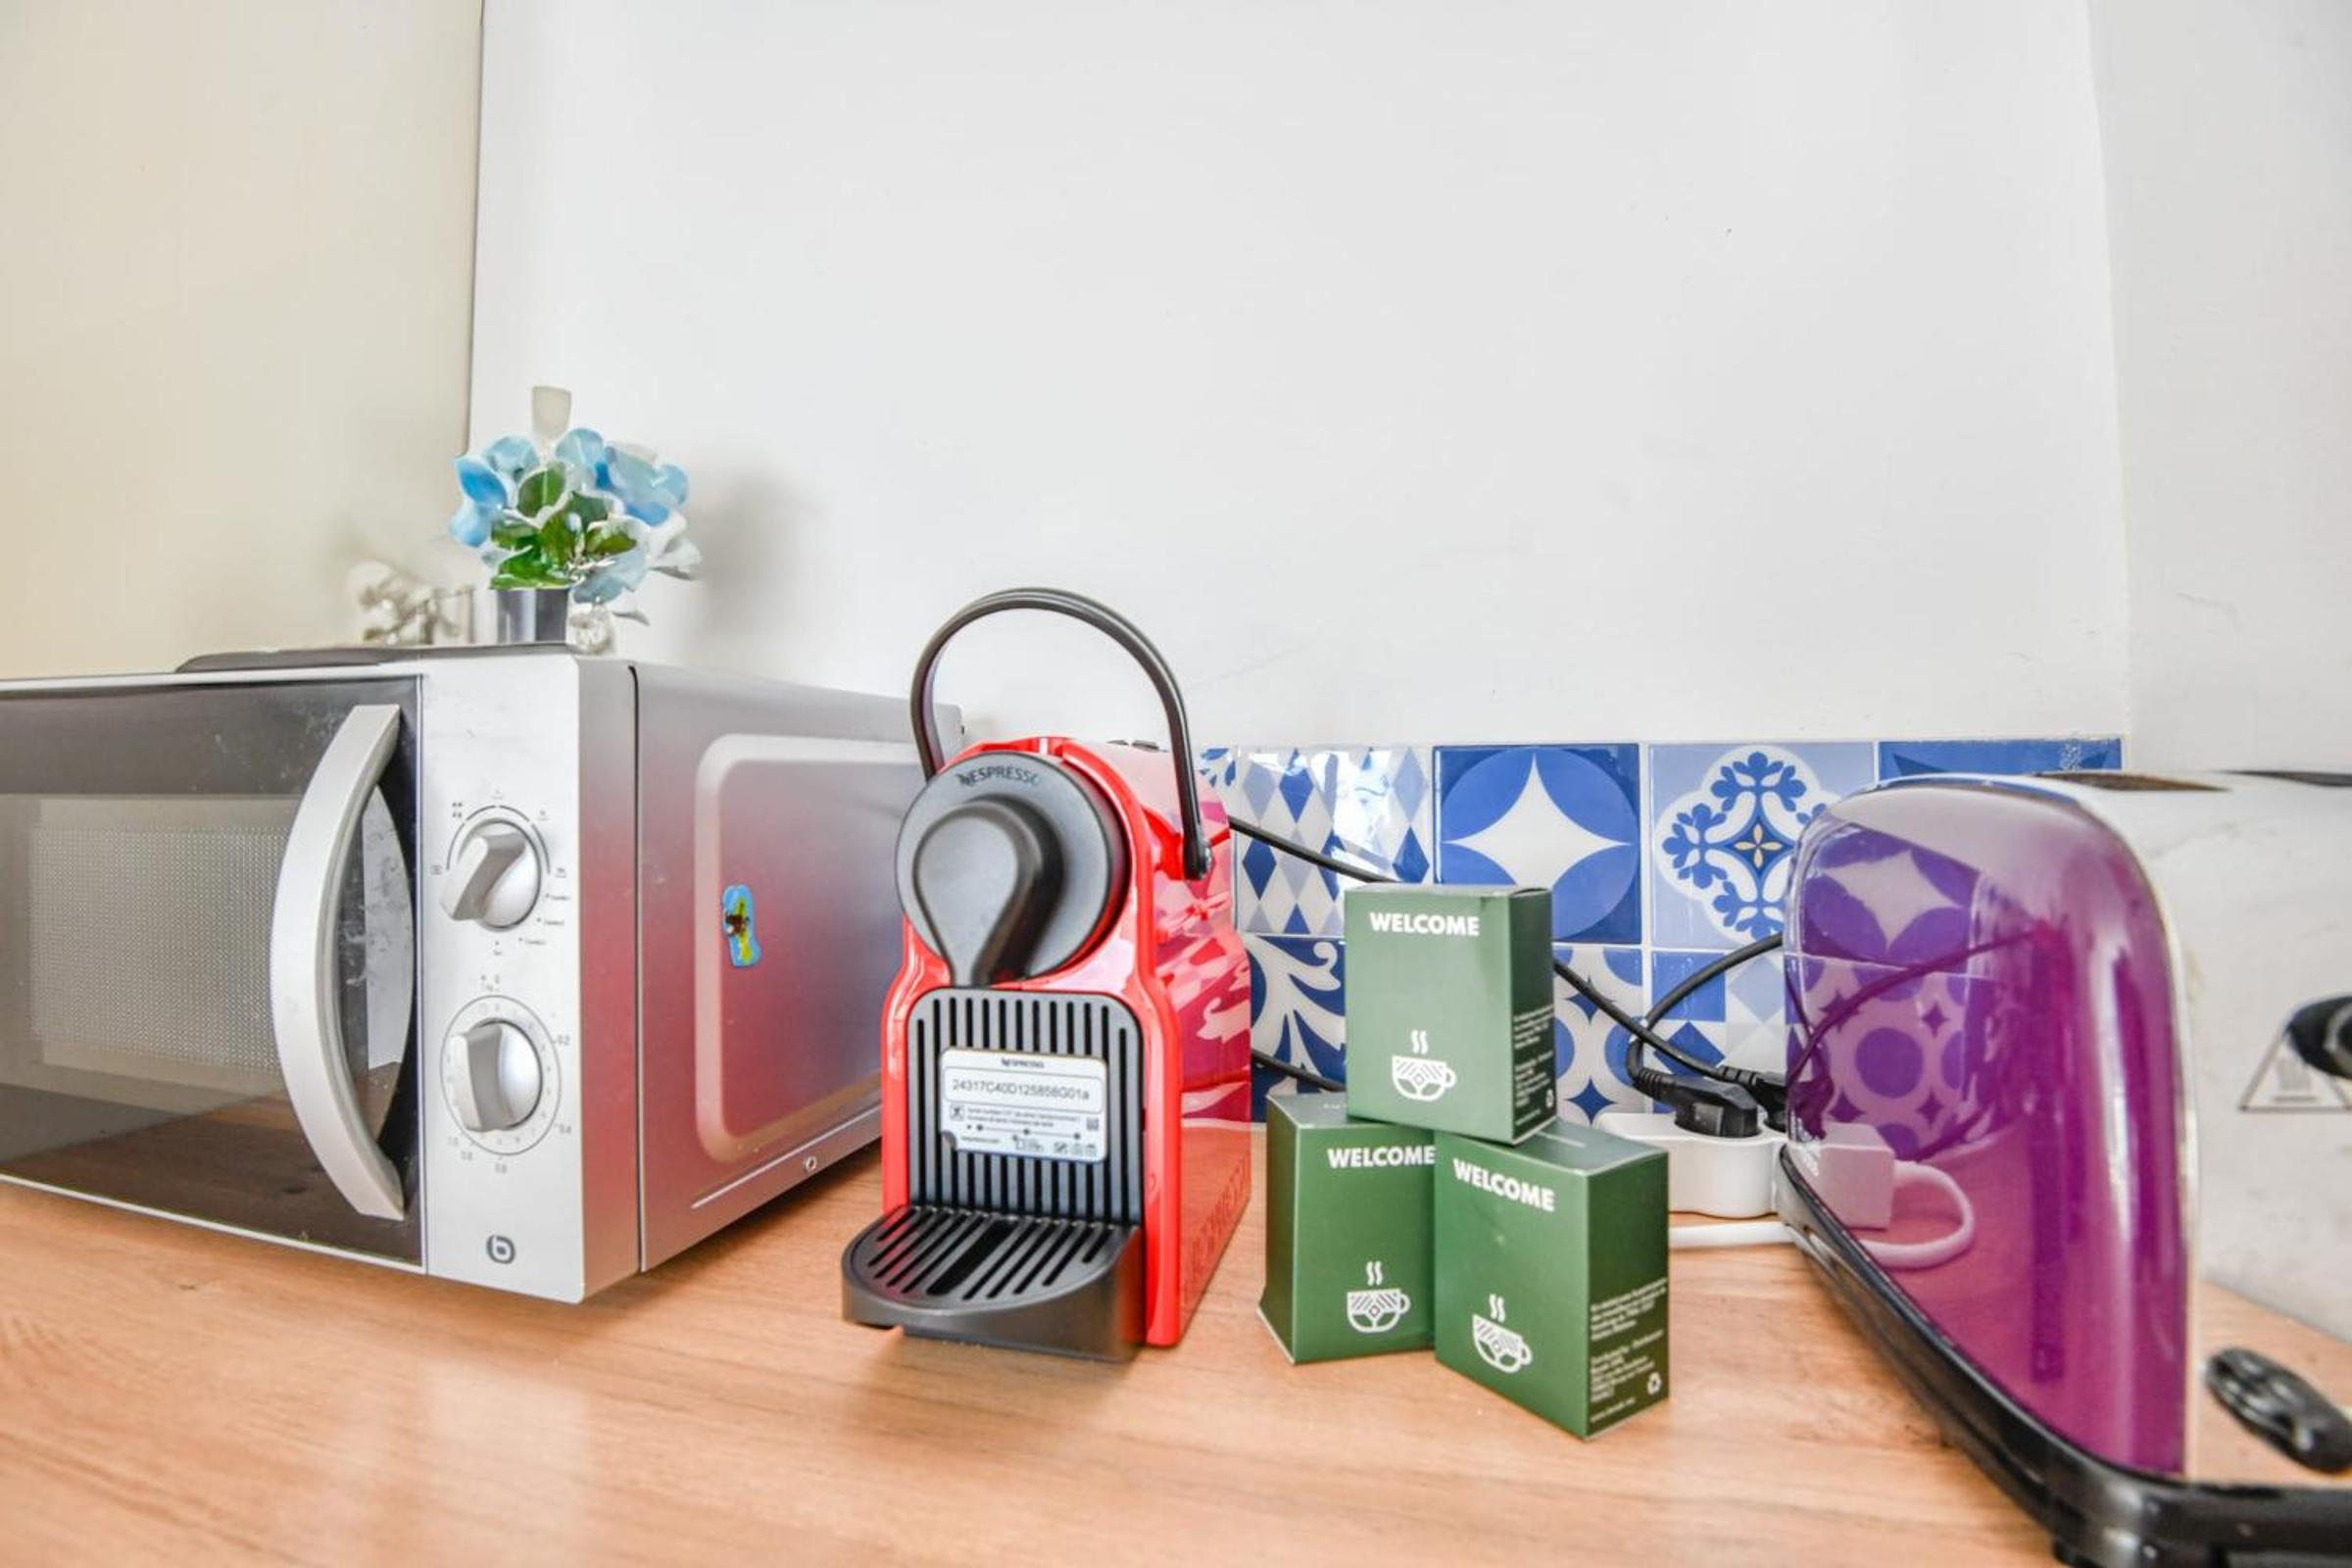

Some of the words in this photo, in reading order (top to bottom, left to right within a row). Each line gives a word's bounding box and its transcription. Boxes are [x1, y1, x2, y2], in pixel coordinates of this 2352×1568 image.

[1370, 911, 1480, 936] WELCOME
[1327, 1145, 1436, 1169] WELCOME
[1453, 1157, 1555, 1213] WELCOME
